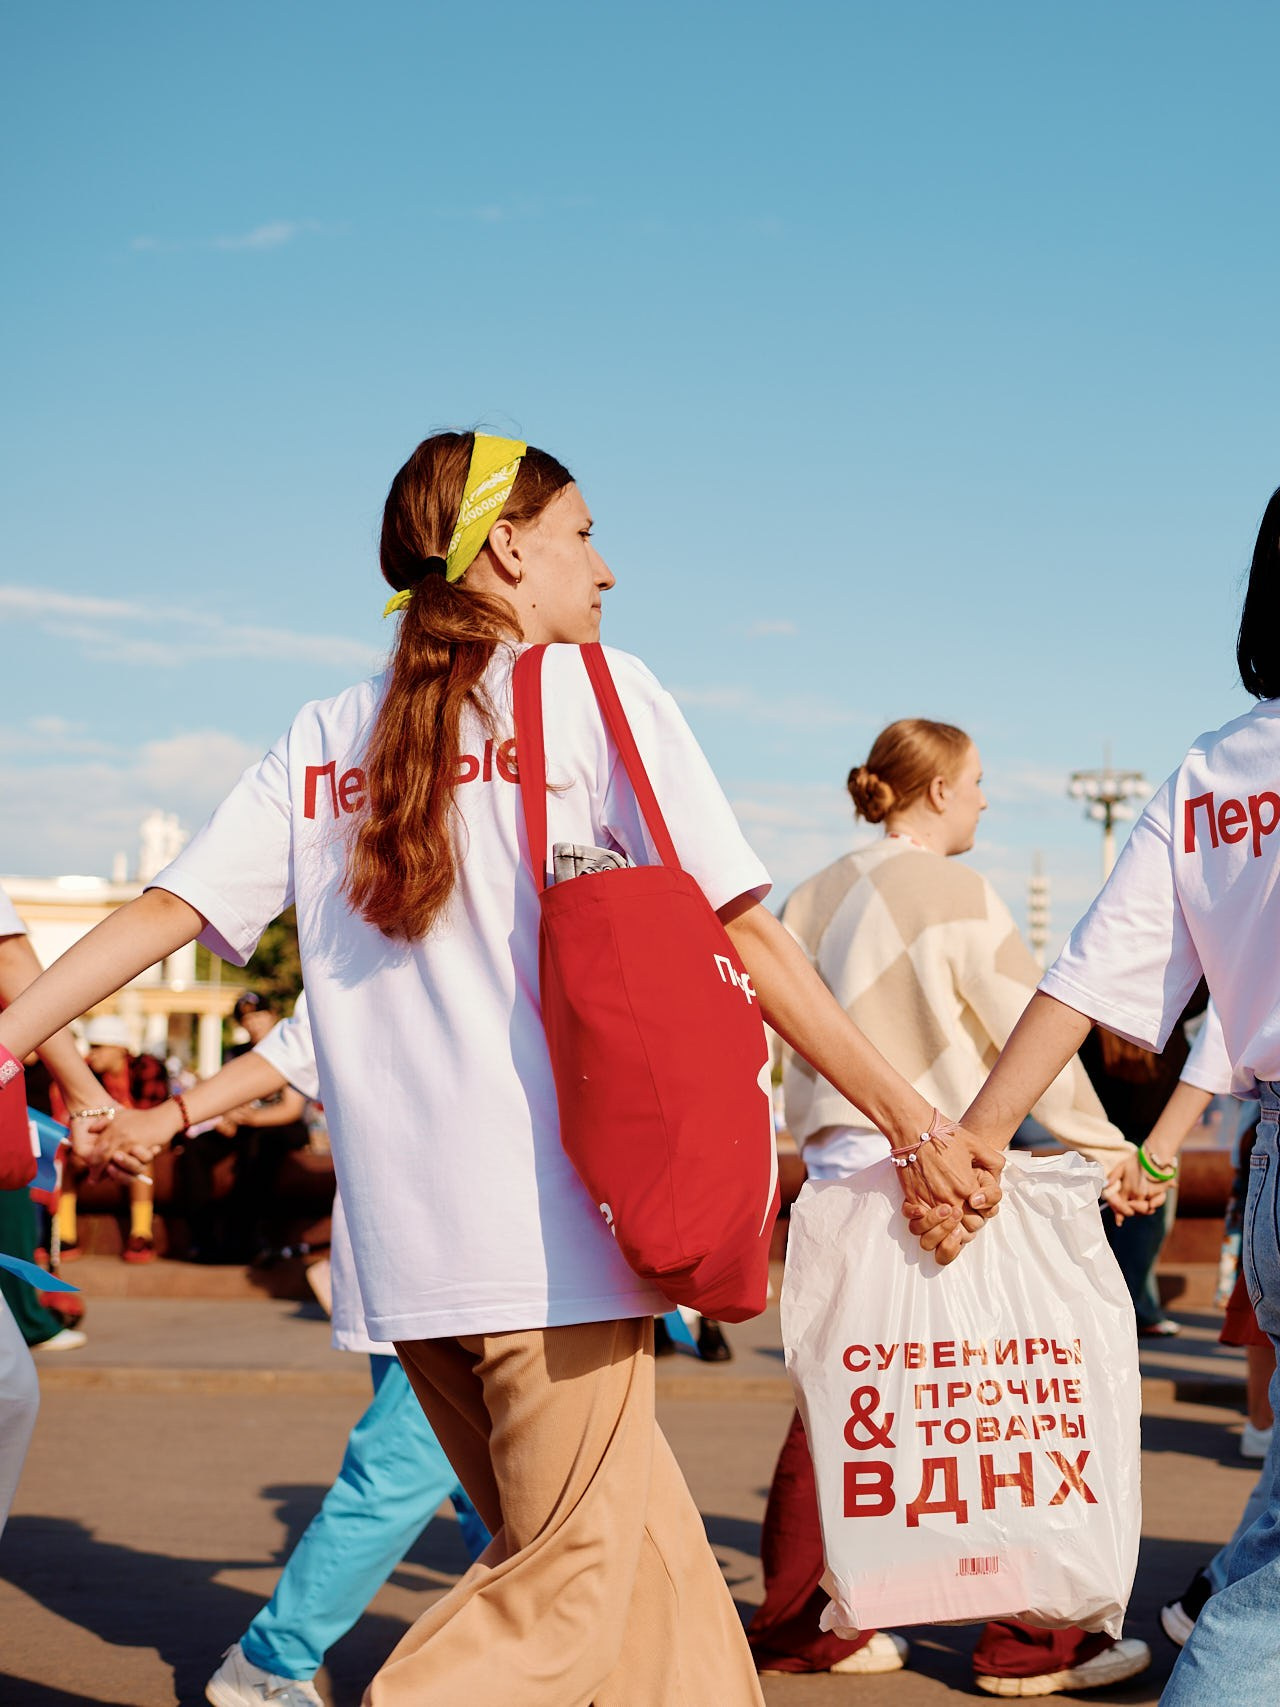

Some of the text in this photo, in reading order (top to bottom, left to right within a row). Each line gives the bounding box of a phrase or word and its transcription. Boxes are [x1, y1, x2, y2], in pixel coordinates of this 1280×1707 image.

[304, 738, 521, 820] Пеые
[842, 1337, 1082, 1372] СУВЕНИРЫ
[843, 1385, 896, 1451] &
[914, 1378, 1082, 1409] ПРОЧИЕ
[915, 1413, 1087, 1446] ТОВАРЫ
[843, 1450, 1099, 1528] ВДНХ
